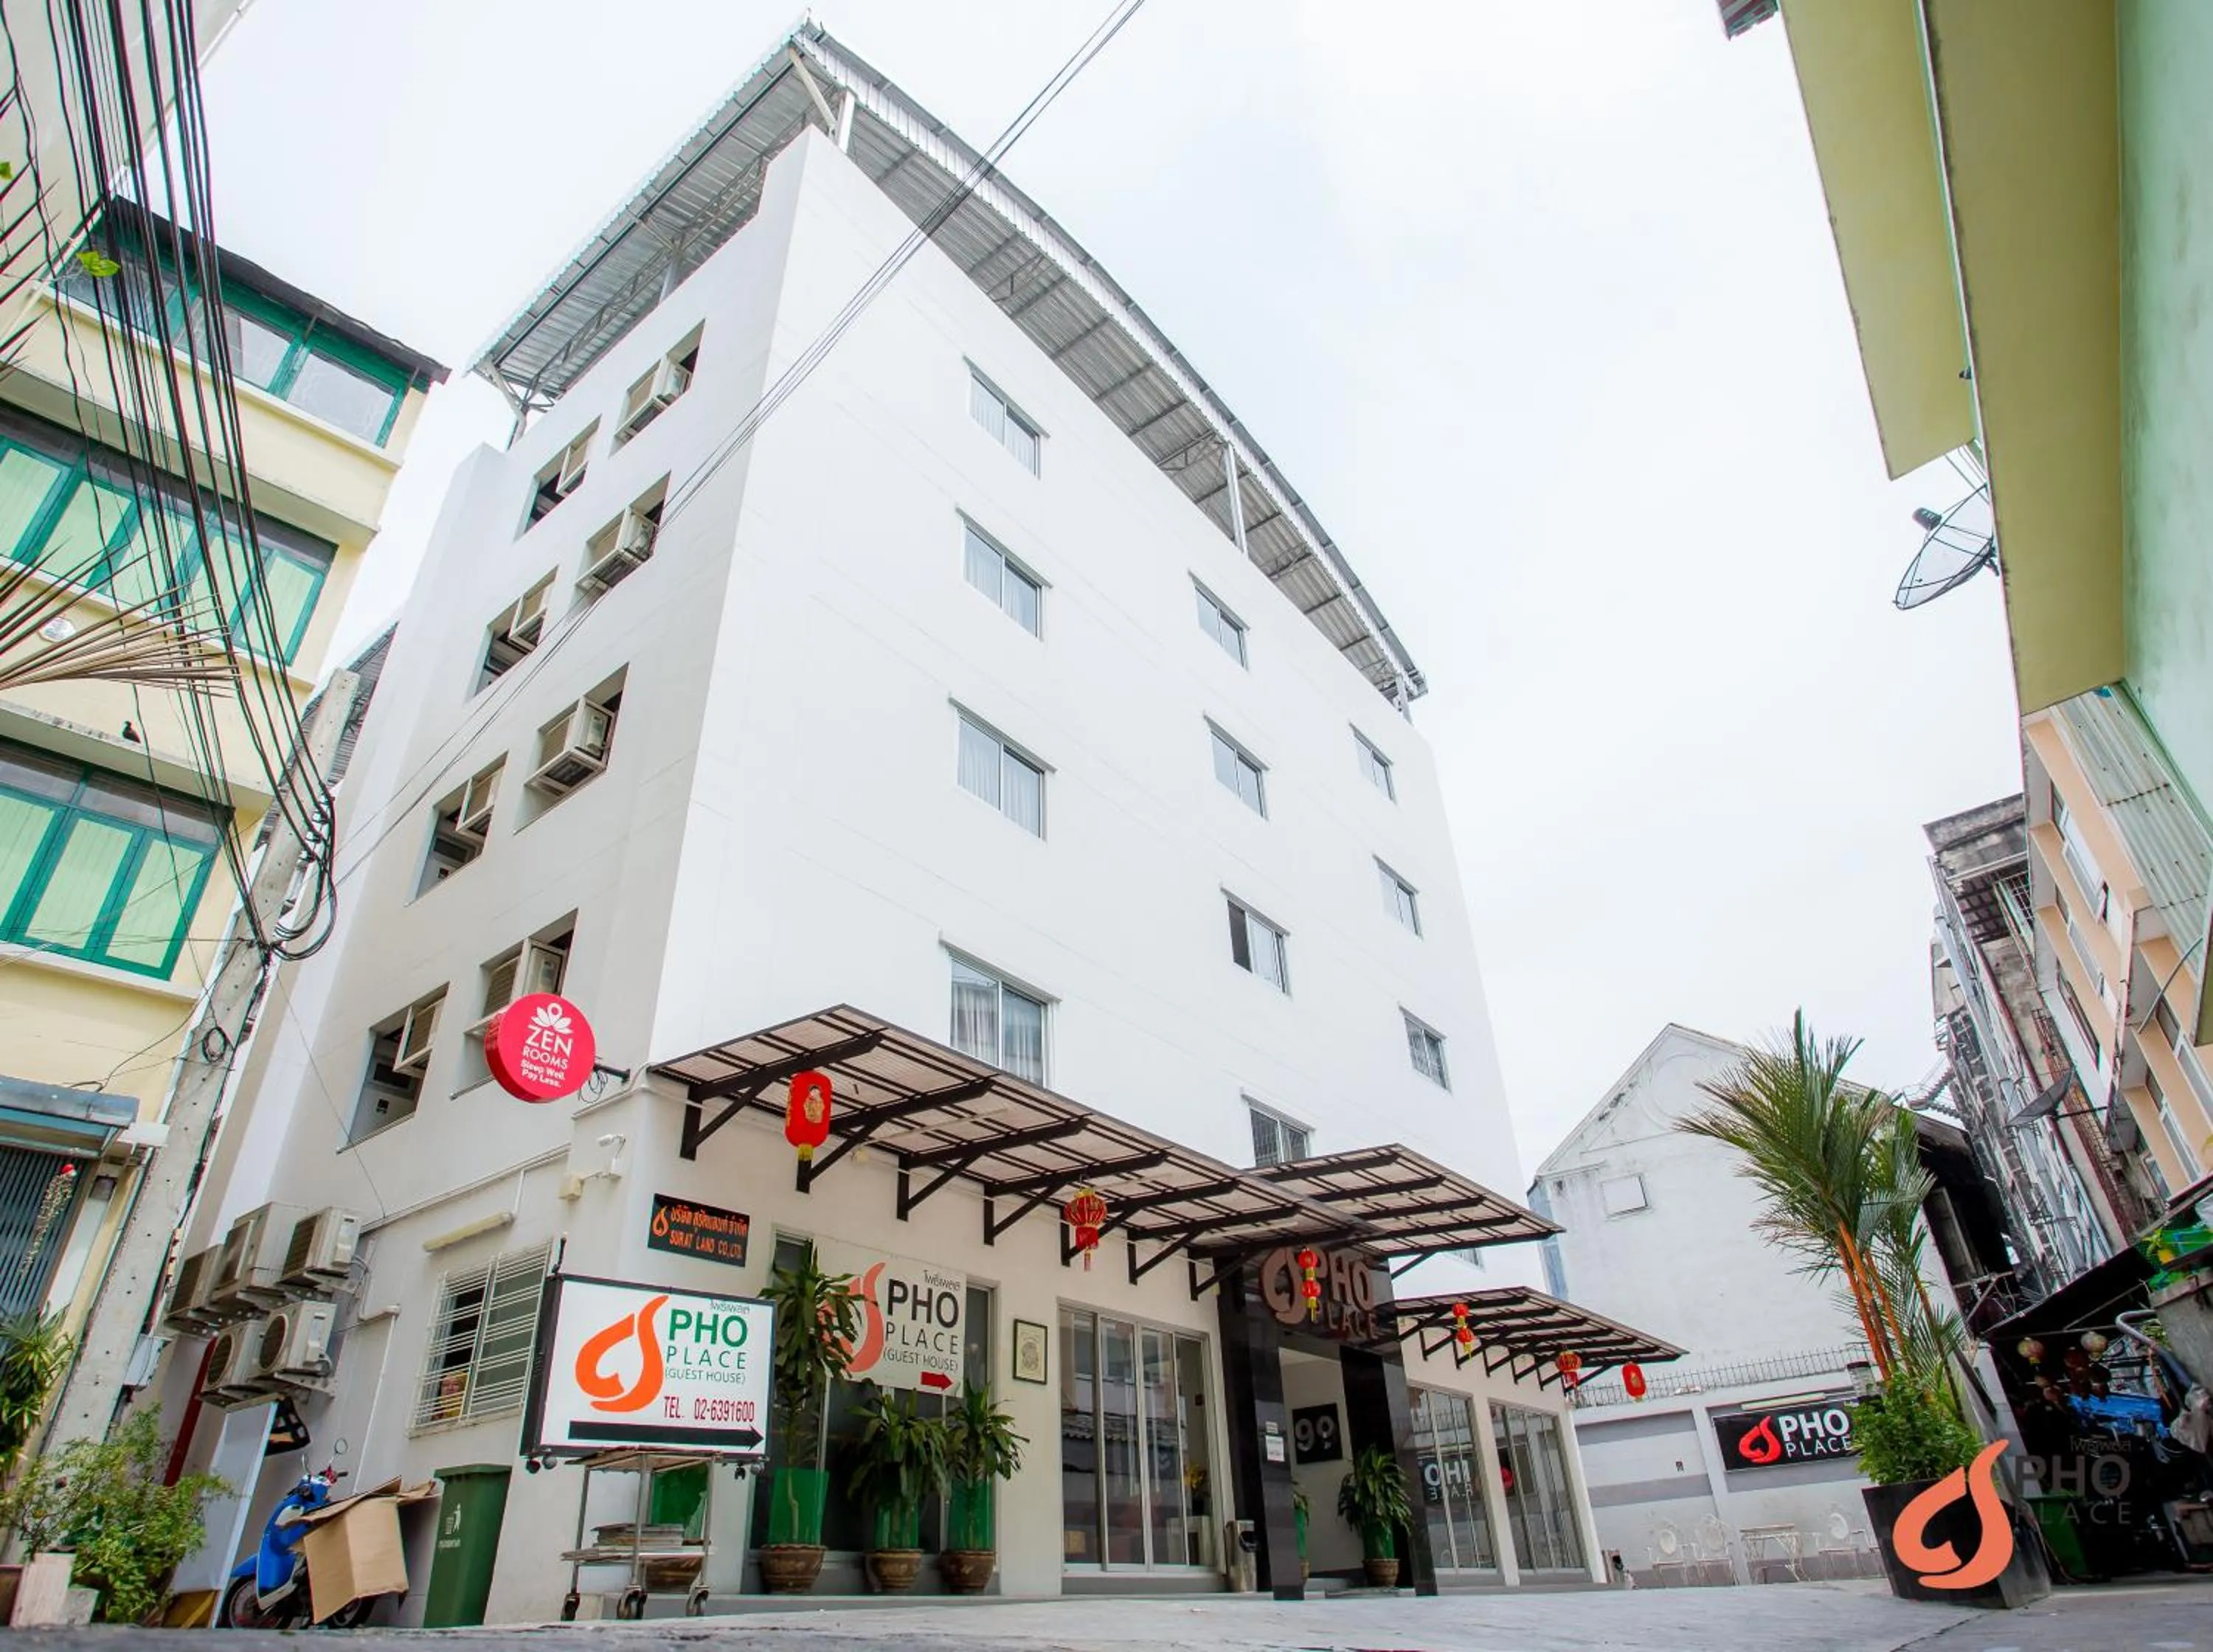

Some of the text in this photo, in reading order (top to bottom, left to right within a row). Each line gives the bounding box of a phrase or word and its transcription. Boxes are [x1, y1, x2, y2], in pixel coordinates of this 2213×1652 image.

[525, 1024, 573, 1058] ZEN
[522, 1045, 569, 1069] ROOMS
[696, 1235, 715, 1253] LAND
[887, 1278, 958, 1328] PHO
[668, 1308, 748, 1347] PHO
[885, 1321, 958, 1355] PLACE
[666, 1346, 747, 1370] PLACE
[884, 1347, 958, 1371] (GUEST HOUSE)
[665, 1367, 746, 1385] (GUEST HOUSE)
[664, 1396, 755, 1423] TEL. 02-6391600
[1778, 1409, 1849, 1442] PHO
[1785, 1436, 1853, 1457] PLACE
